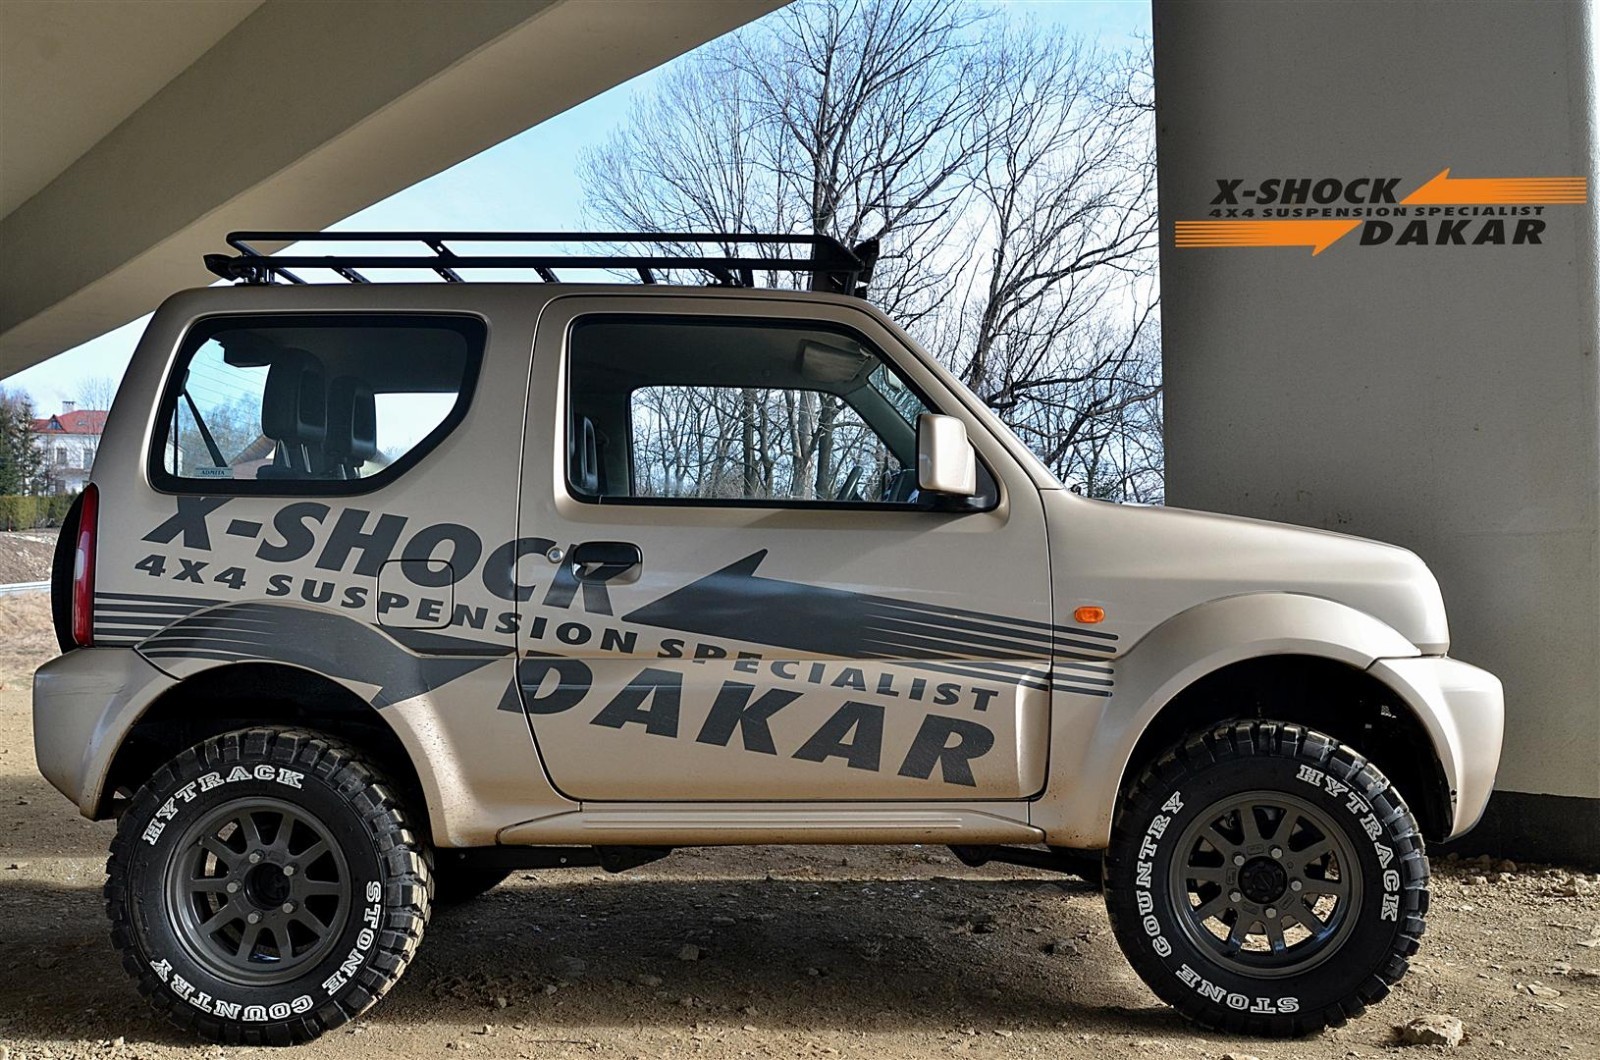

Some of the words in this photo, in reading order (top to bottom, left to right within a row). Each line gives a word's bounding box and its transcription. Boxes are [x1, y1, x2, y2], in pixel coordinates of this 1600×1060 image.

[141, 496, 636, 617] X-SHOCK
[134, 554, 247, 590] 4X4
[265, 574, 639, 654] SUSPENSION
[657, 638, 999, 711] SPECIALIST
[497, 650, 996, 787] DAKAR
[142, 764, 305, 845] HYTRACK
[1296, 763, 1400, 922] HYTRACK
[1135, 790, 1184, 957] COUNTRY
[150, 958, 314, 1022] COUNTRY
[322, 880, 381, 996] STONE
[1175, 963, 1300, 1014] STONE
